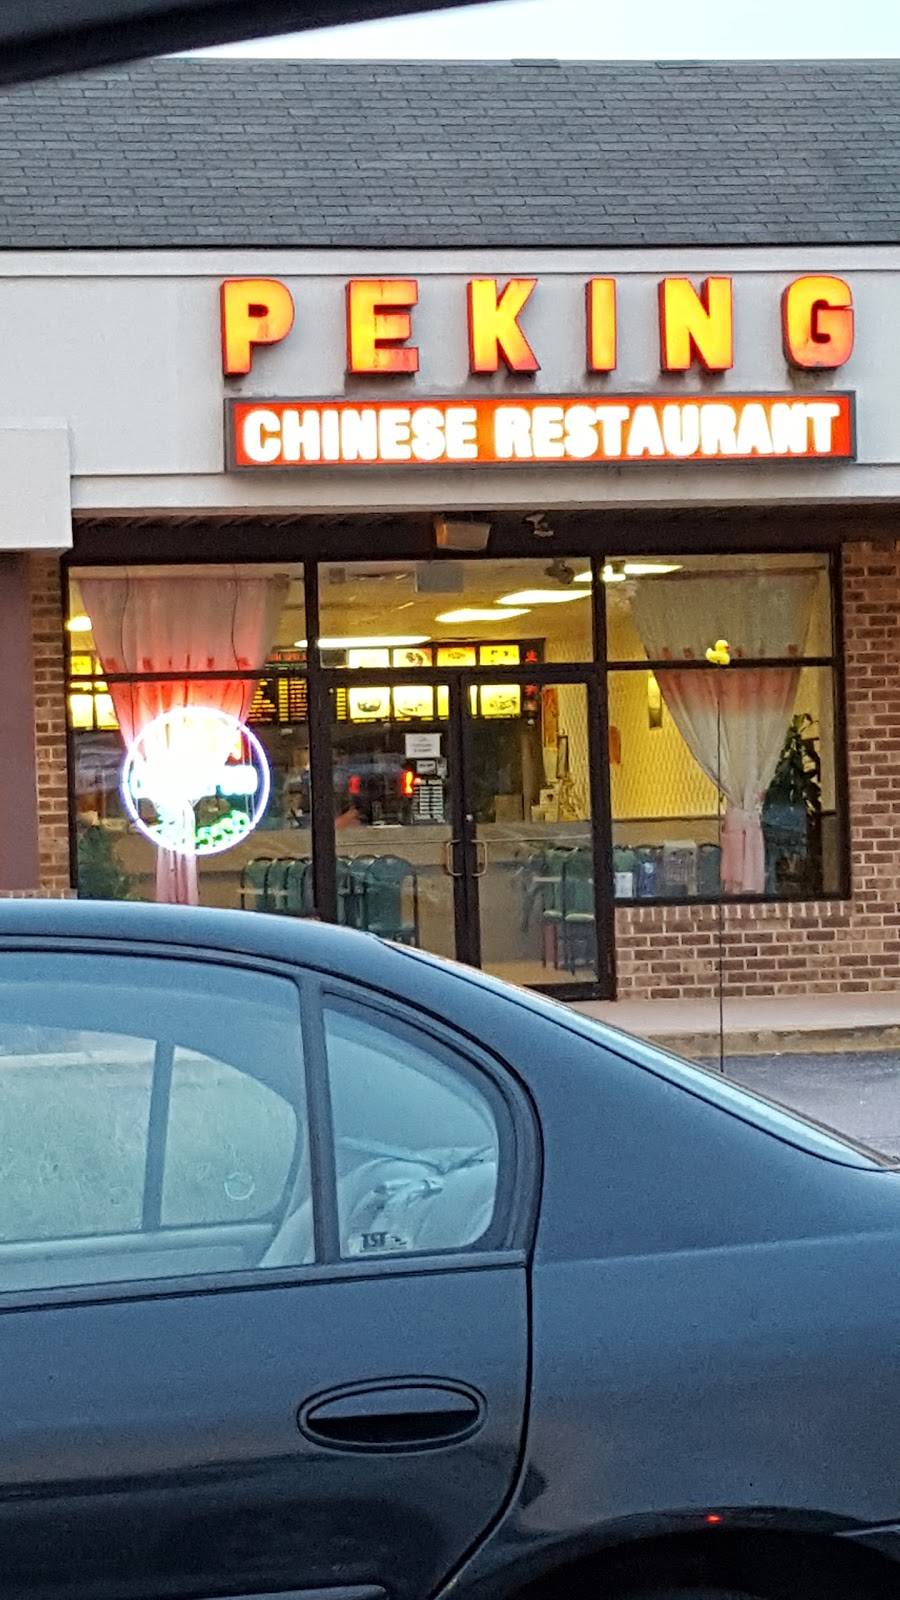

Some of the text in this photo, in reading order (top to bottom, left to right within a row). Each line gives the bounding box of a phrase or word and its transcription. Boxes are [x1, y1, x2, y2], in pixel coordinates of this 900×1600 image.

[220, 274, 854, 376] PEKING
[243, 402, 841, 463] CHINESE RESTAURANT
